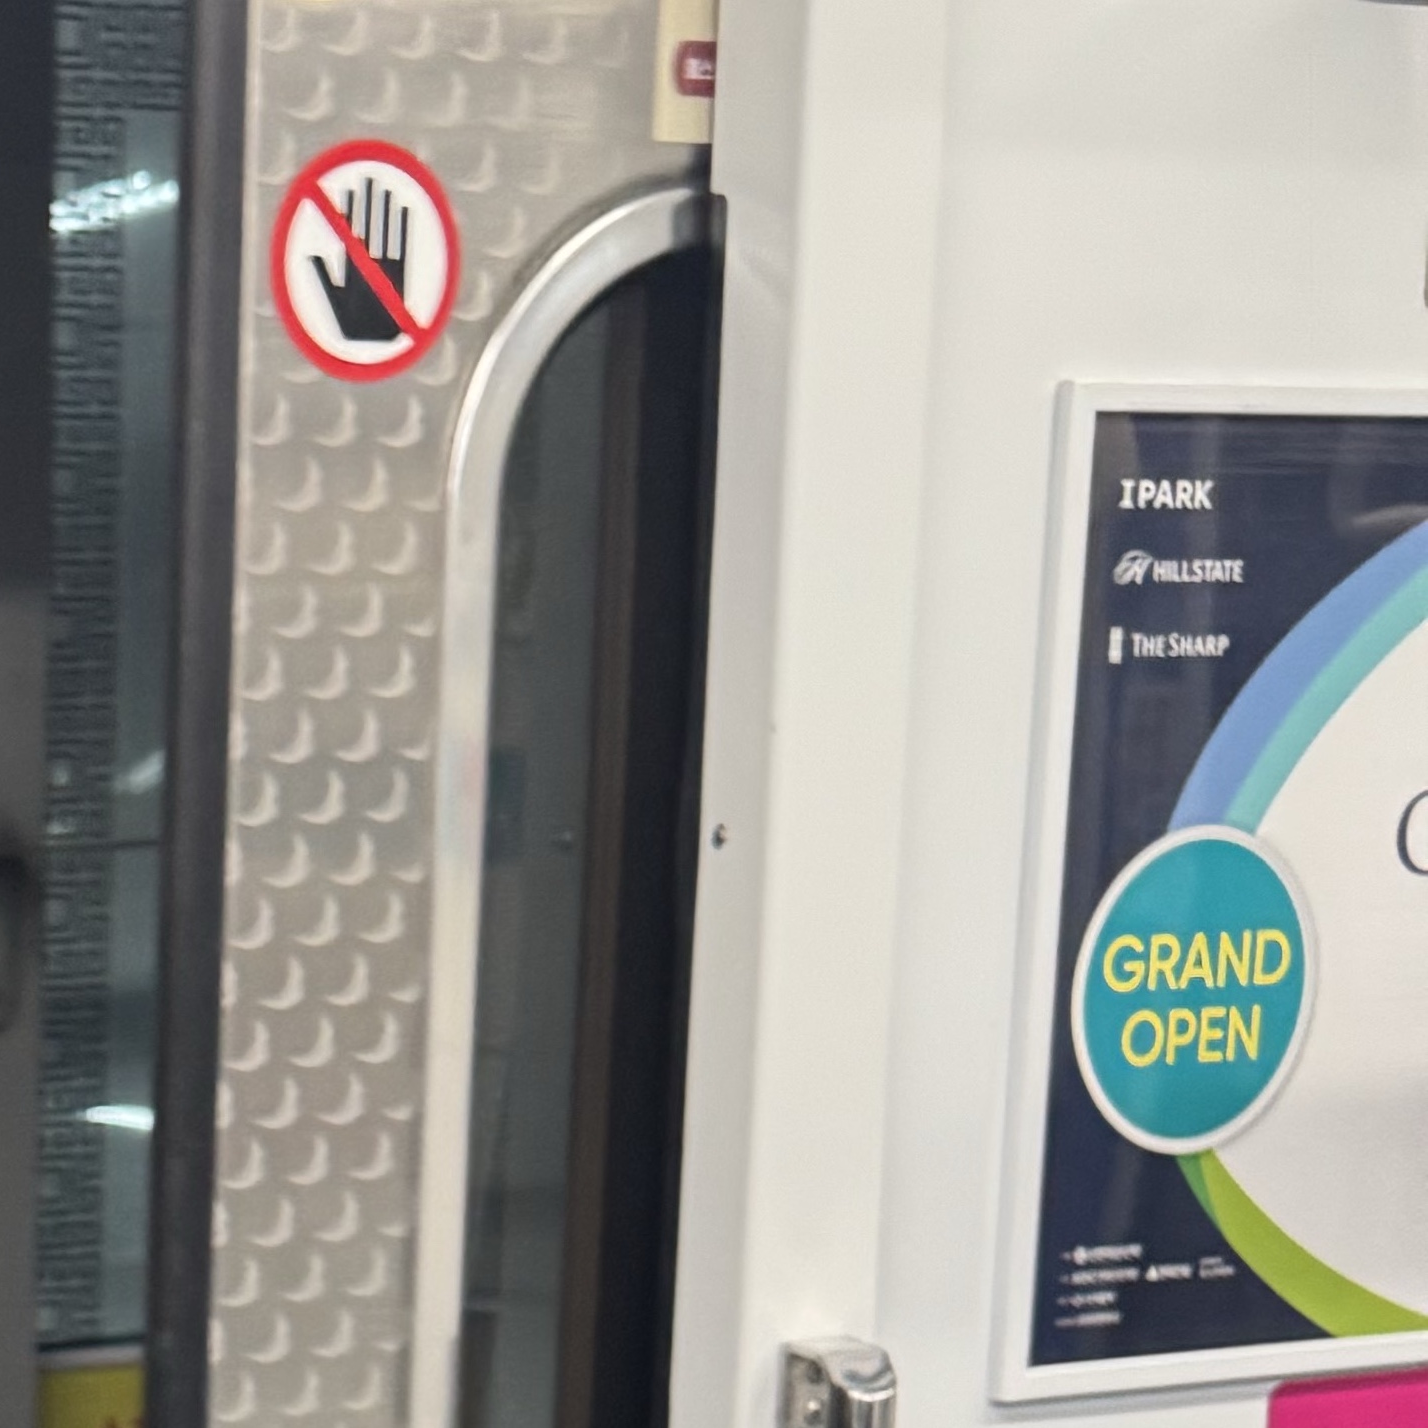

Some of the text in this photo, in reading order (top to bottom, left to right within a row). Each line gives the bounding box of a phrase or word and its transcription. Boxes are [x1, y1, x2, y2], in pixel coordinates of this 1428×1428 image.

[1152, 558, 1245, 585] HILLSTATE
[1102, 928, 1292, 993] GRAND
[1121, 1004, 1262, 1068] OPEN
